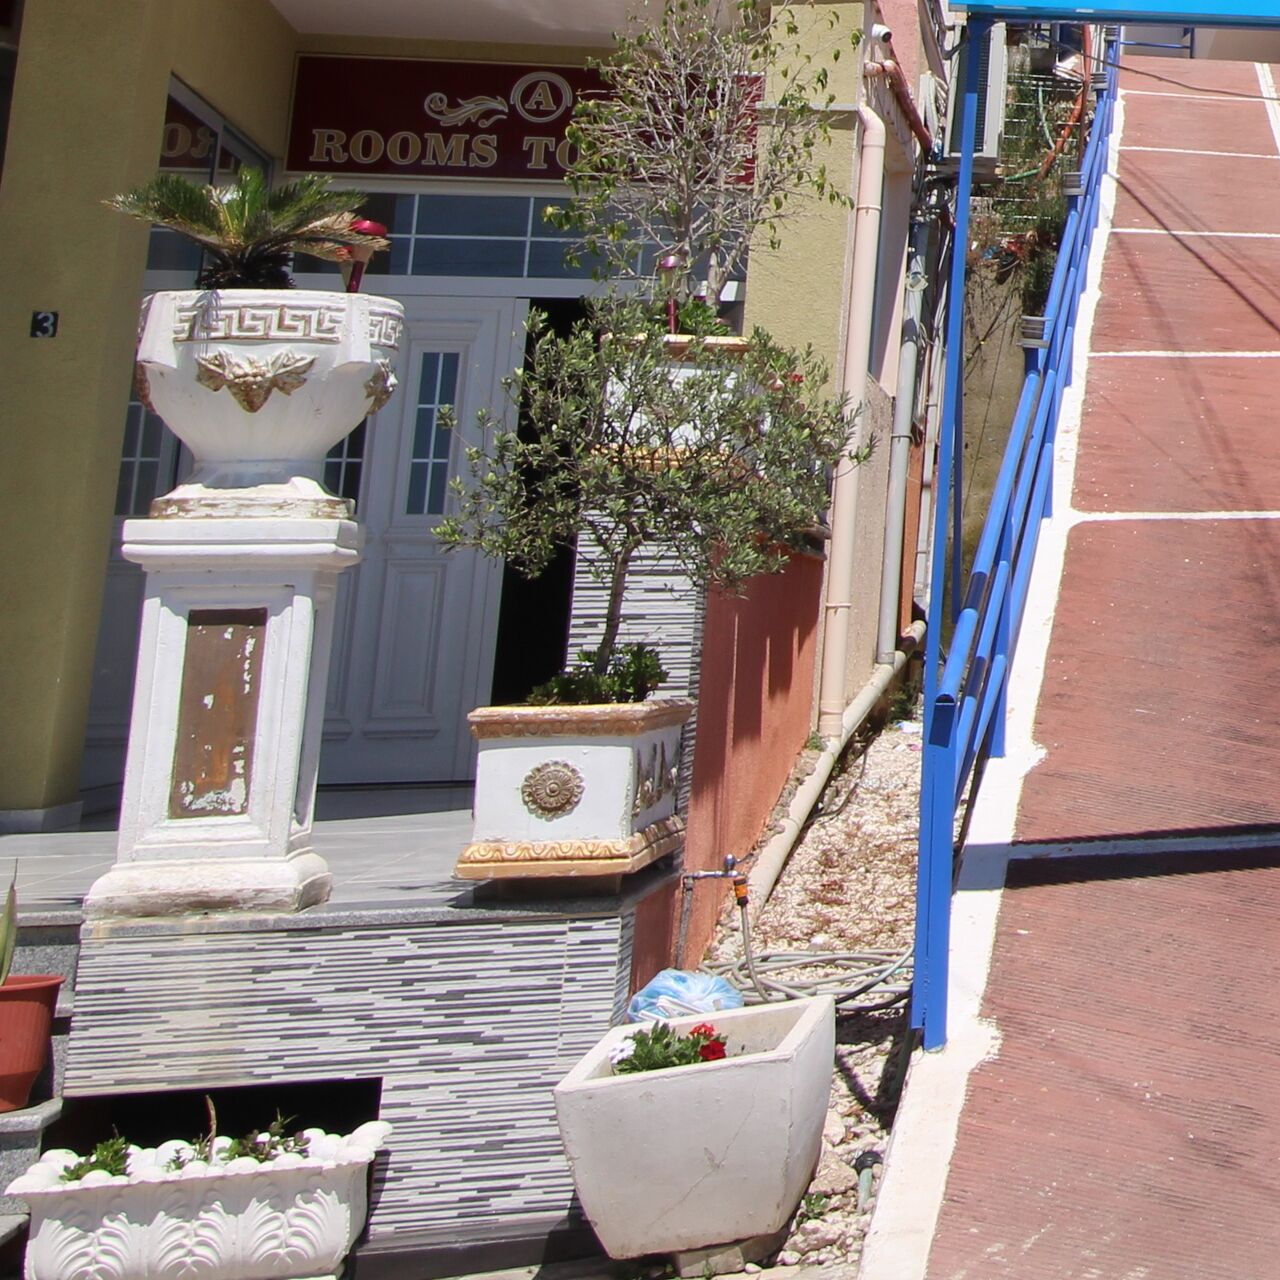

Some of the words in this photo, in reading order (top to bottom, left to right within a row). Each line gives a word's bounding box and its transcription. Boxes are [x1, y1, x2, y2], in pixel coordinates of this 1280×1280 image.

[525, 81, 557, 111] A
[309, 129, 498, 168] ROOMS
[36, 312, 54, 338] 3
